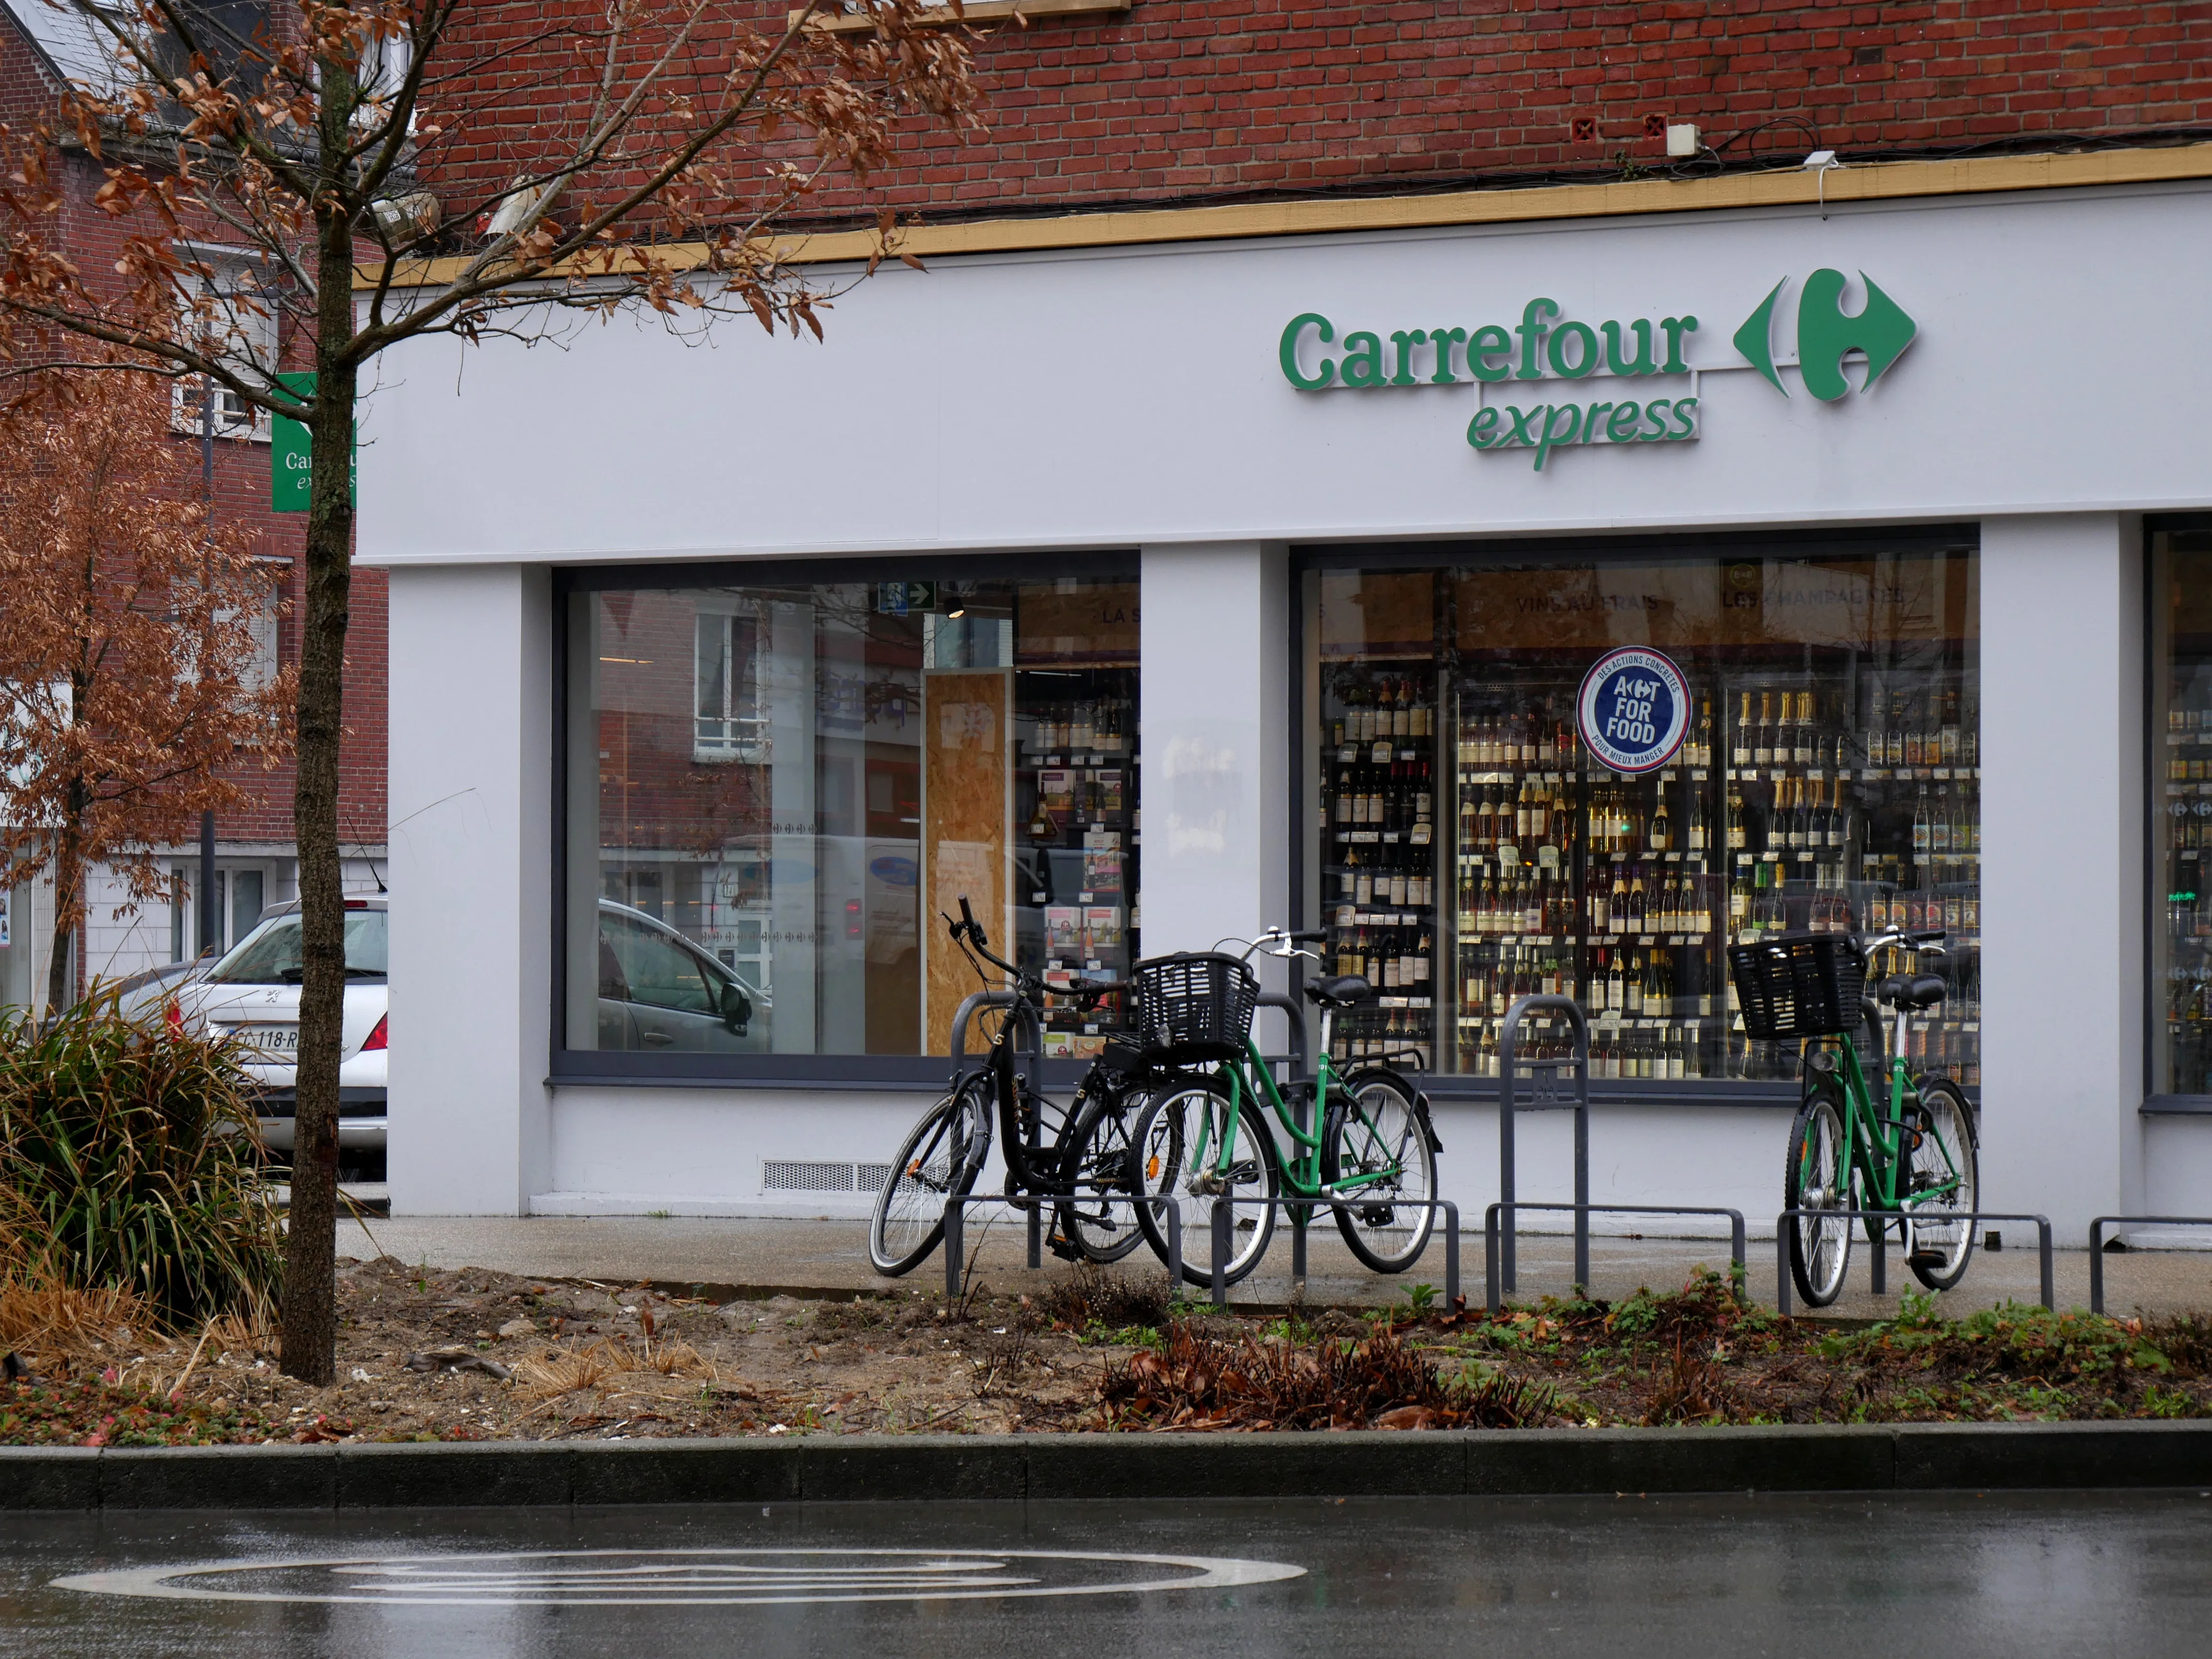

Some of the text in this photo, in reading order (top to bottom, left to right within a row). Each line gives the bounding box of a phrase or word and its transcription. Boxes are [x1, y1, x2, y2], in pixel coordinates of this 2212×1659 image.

[1279, 298, 1698, 390] Carrefour
[1467, 397, 1698, 471] express
[1597, 655, 1680, 693] DES ACTIONS CONCRÈTES
[1615, 697, 1651, 722] FOR
[1606, 717, 1655, 744] FOOD
[1592, 734, 1664, 765] POUR MIEUX MANGER
